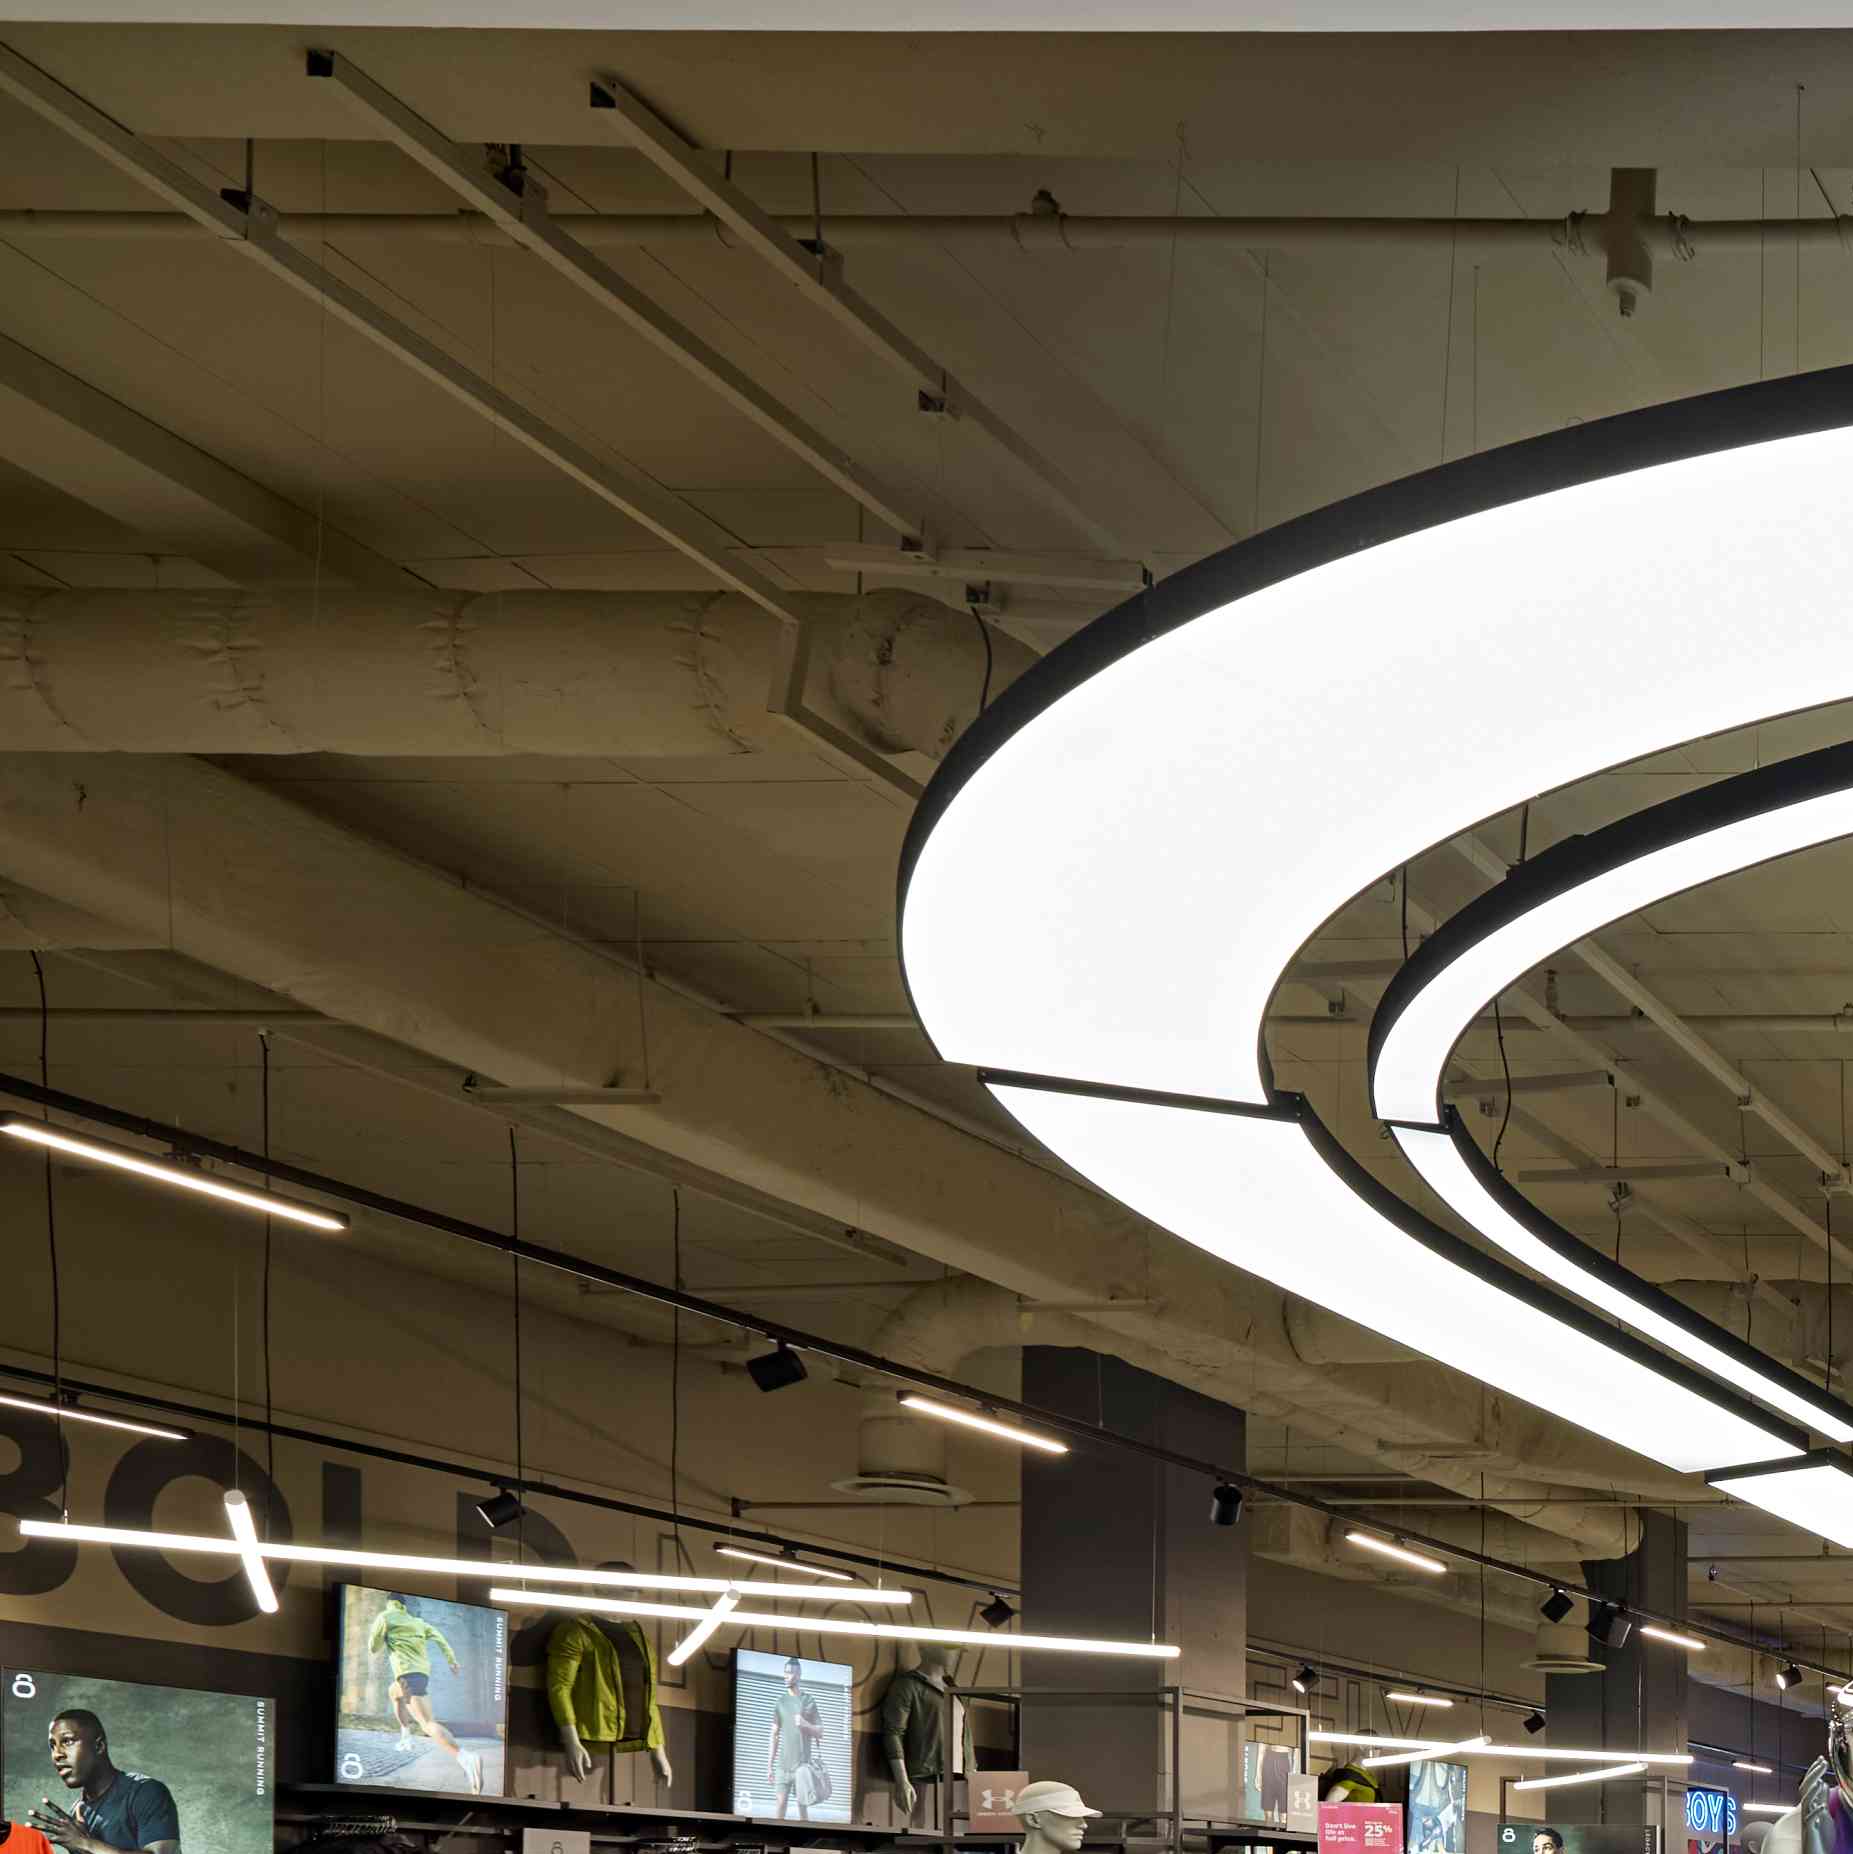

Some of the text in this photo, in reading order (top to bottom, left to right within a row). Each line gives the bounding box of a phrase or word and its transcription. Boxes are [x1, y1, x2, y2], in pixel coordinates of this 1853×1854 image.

[256, 1701, 265, 1796] SUMMIT RUNNING
[1364, 1824, 1393, 1838] 25%
[1686, 1791, 1737, 1836] OYS
